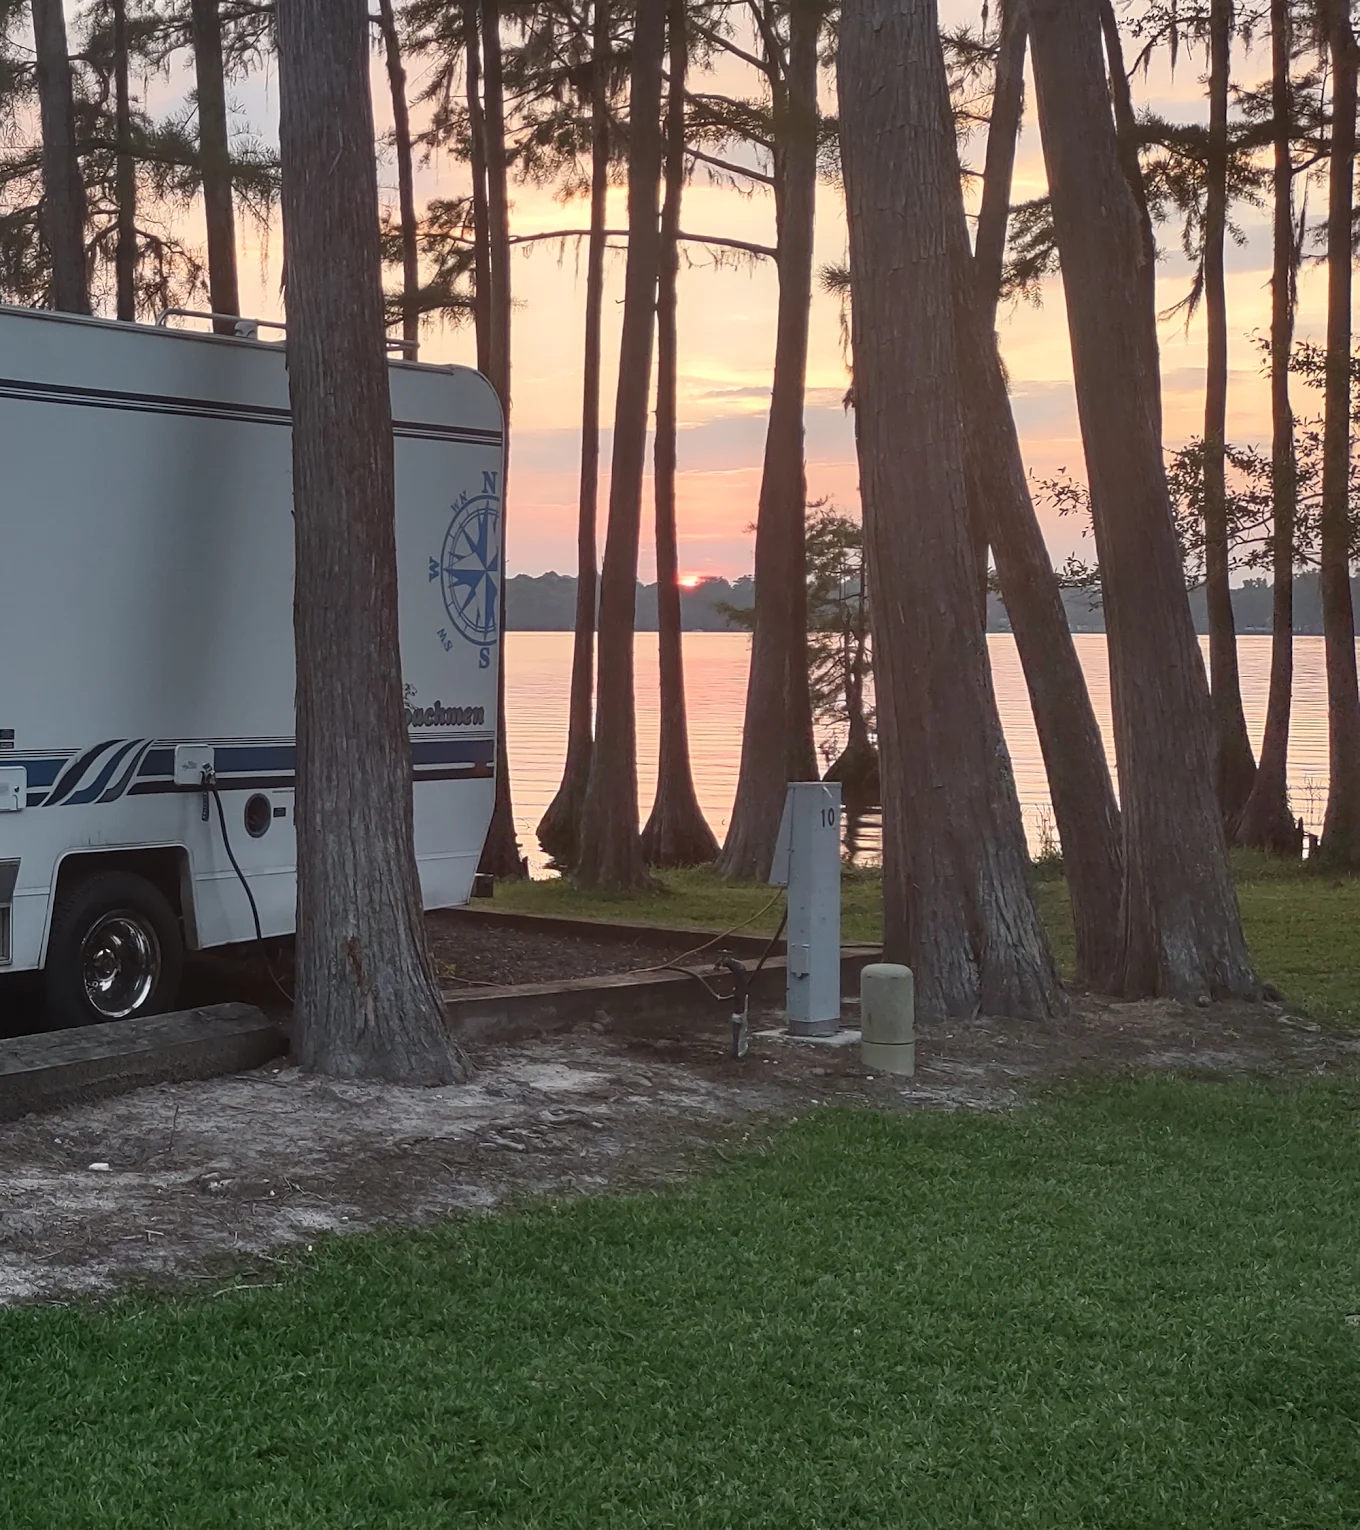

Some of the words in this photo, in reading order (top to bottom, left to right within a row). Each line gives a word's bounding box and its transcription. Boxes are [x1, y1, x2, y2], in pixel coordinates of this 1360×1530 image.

[481, 470, 498, 494] N
[479, 647, 491, 669] S
[404, 700, 485, 727] oachmen
[821, 807, 835, 828] 10
